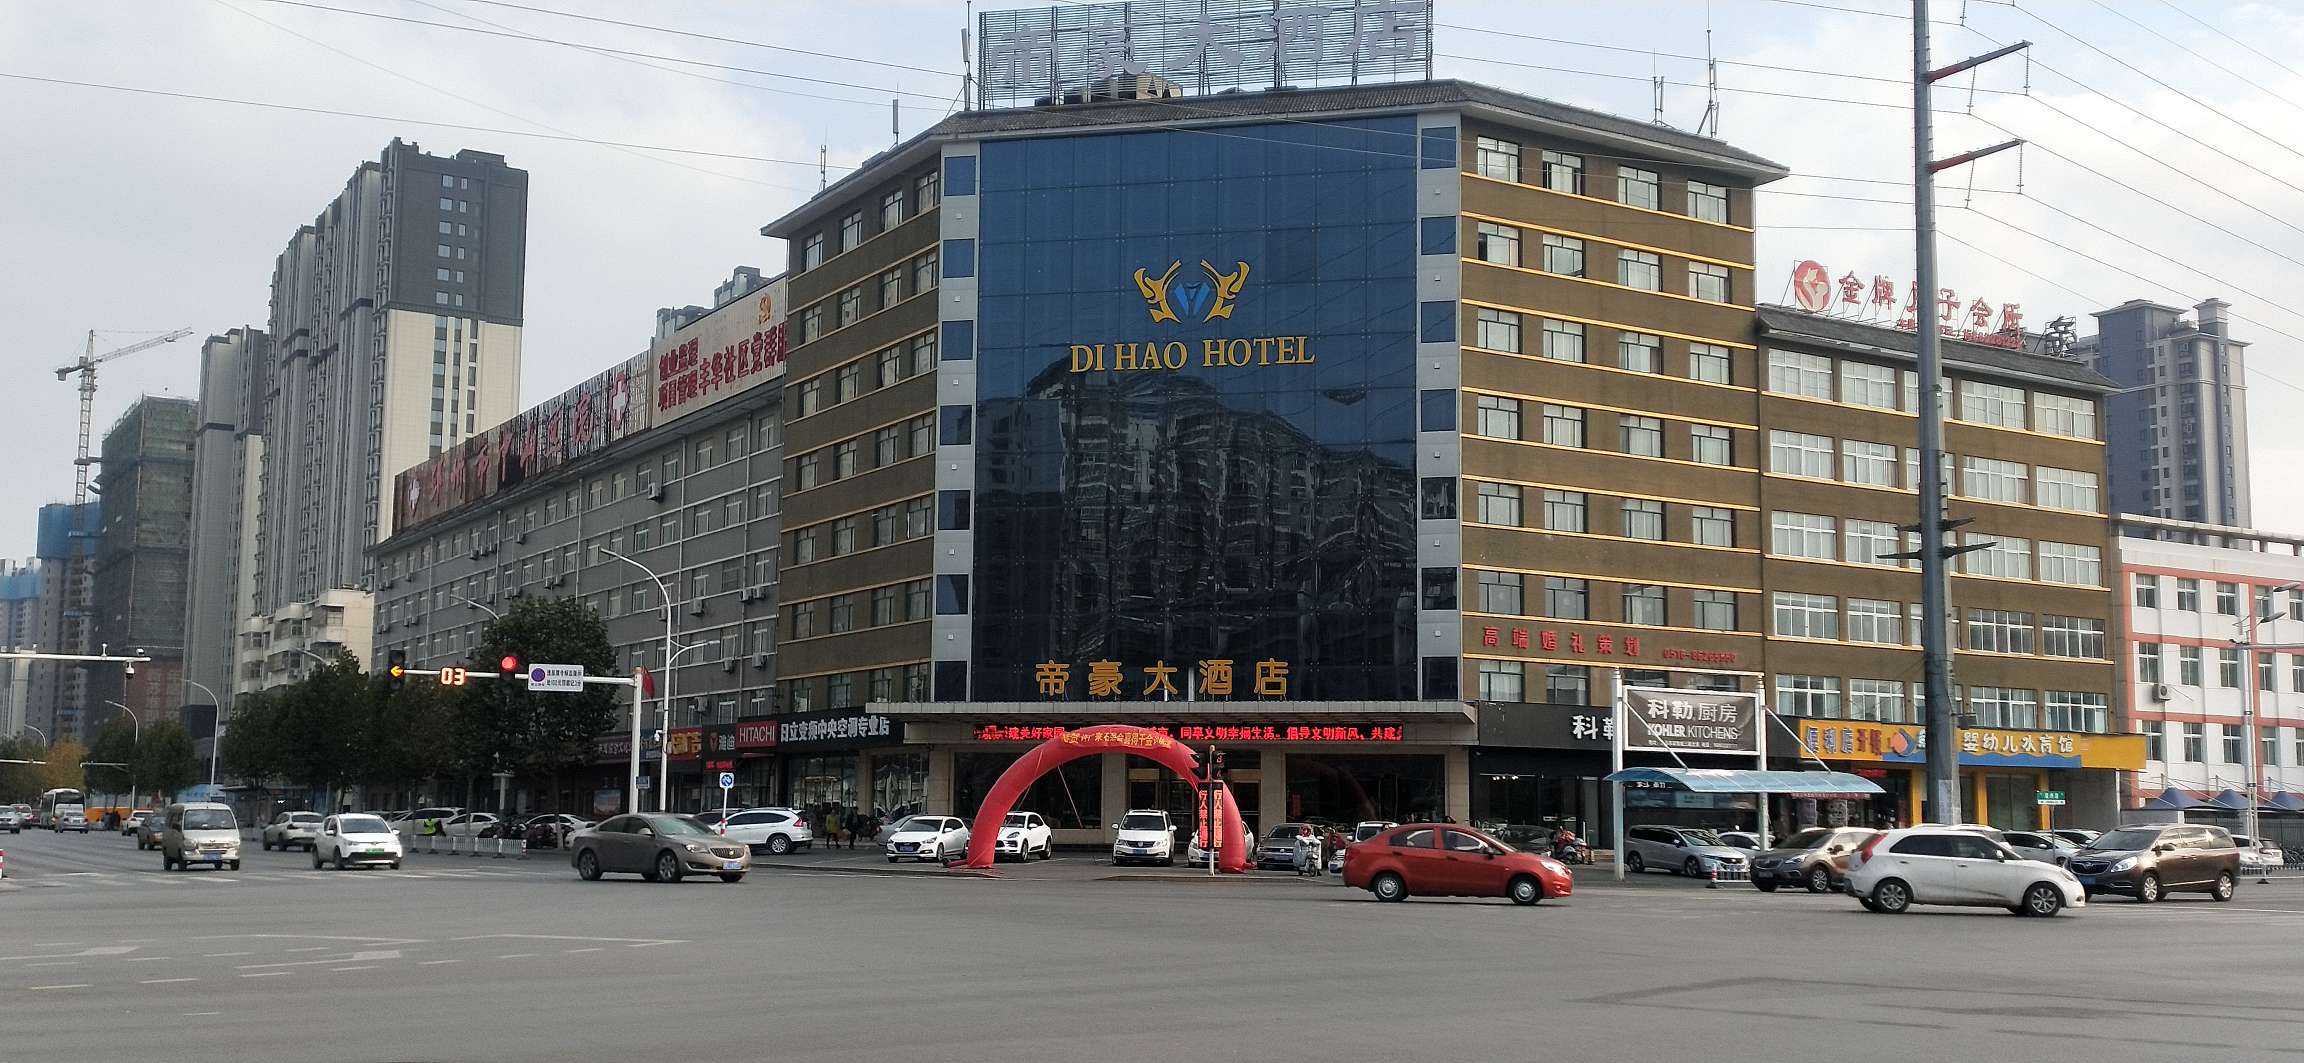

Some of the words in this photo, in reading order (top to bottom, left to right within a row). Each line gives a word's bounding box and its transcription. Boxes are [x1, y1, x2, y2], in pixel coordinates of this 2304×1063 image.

[991, 2, 1425, 83] 帝豪大酒店
[1838, 270, 2023, 342] 金牌子会所
[1070, 344, 1105, 372] DI
[1113, 341, 1188, 371] HAO
[1203, 336, 1316, 367] HOTEL
[1483, 626, 1641, 657] 高端婚礼策划
[441, 667, 465, 686] 03
[1035, 657, 1289, 696] 帝豪大酒店
[739, 725, 775, 743] HITACHI
[780, 714, 890, 743] 日立变频中央空调专业店
[1648, 723, 1687, 738] KOHLER
[1688, 724, 1739, 740] KITCHENS
